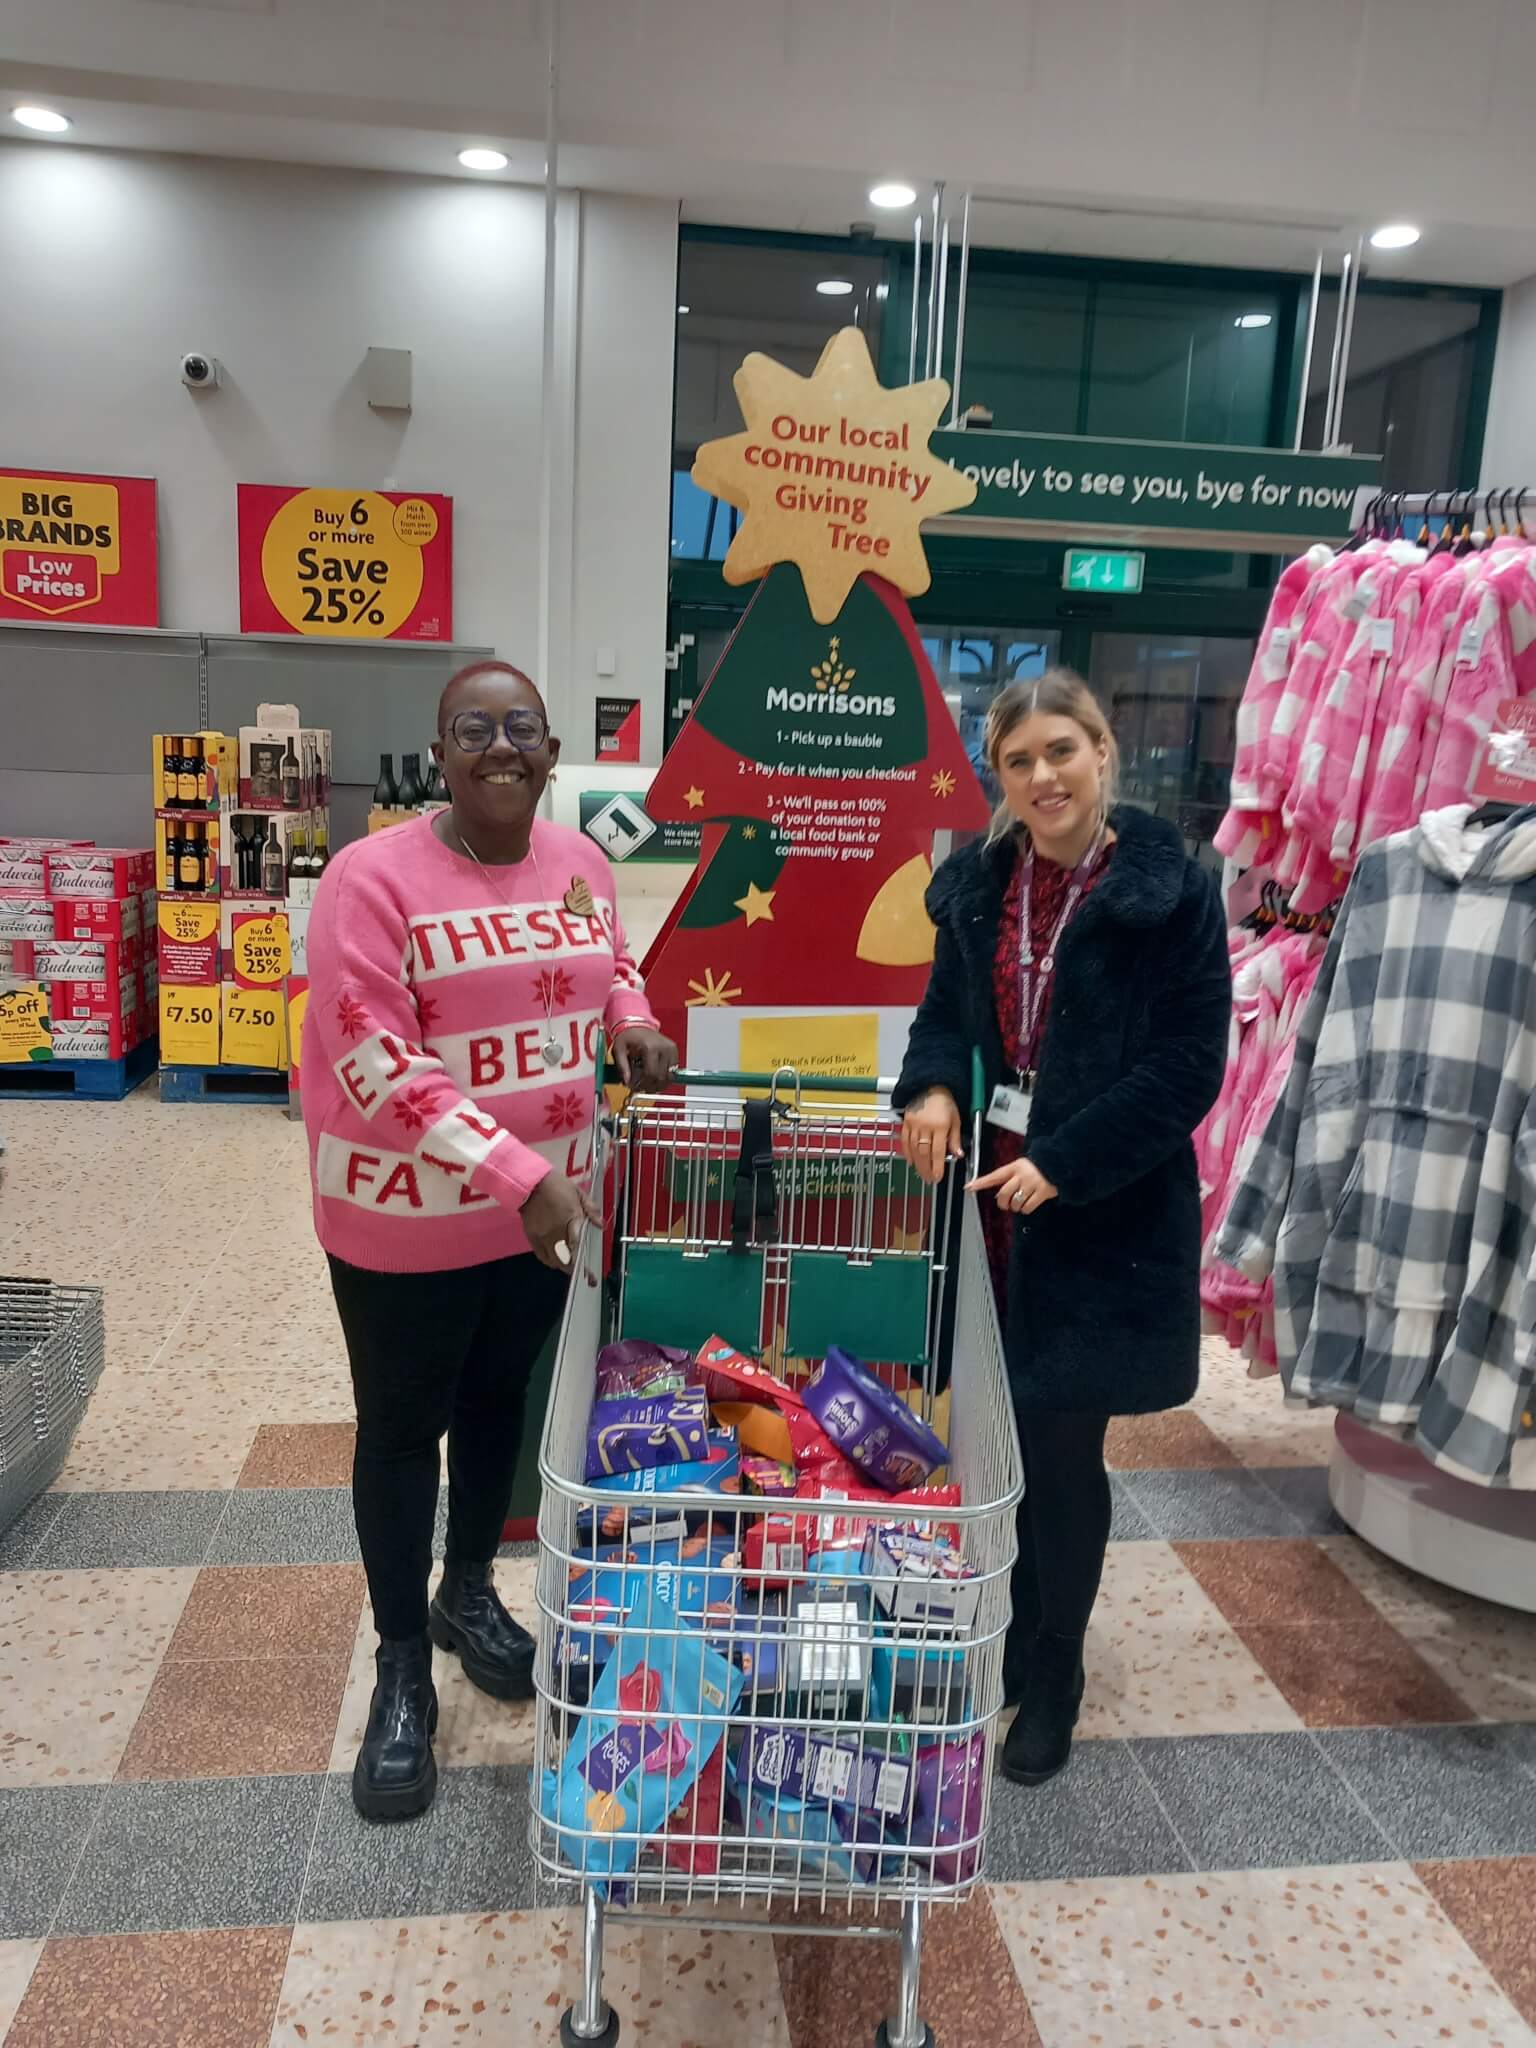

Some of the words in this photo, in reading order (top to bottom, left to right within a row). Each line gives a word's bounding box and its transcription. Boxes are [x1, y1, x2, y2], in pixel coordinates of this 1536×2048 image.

[772, 415, 831, 445] Our
[839, 417, 909, 451] local
[744, 445, 931, 503] community
[1042, 468, 1073, 492] to
[1080, 472, 1124, 497] see
[1130, 476, 1188, 504] you,
[1197, 471, 1244, 509] bye
[1249, 477, 1291, 506] for
[1297, 485, 1353, 510] now
[22, 492, 73, 518] BIG
[314, 508, 345, 529] Buy
[350, 498, 369, 526] 6
[775, 484, 869, 524] Giving
[308, 530, 327, 542] or
[332, 531, 375, 545] more
[827, 522, 890, 557] Tree
[28, 555, 73, 576] Low
[297, 547, 389, 584] Save
[17, 574, 86, 597] Prices
[301, 586, 385, 625] 25%
[765, 686, 897, 716] Morrisons
[776, 730, 782, 743] 1
[791, 730, 815, 745] Pick
[817, 734, 833, 749] up
[834, 736, 842, 746] a
[843, 731, 883, 748] bauble
[738, 761, 746, 775] 2
[755, 761, 776, 779] Pay
[777, 762, 796, 777] for
[797, 763, 806, 777] it
[808, 763, 840, 779] when
[841, 767, 865, 782] you
[865, 765, 917, 782] checkout
[766, 794, 774, 808] 3
[783, 794, 812, 810] We'll
[814, 799, 839, 813] pass
[840, 800, 856, 811] on
[858, 798, 887, 812] 100%
[771, 810, 786, 825] of
[787, 813, 813, 828] your
[814, 811, 866, 827] donation
[867, 814, 881, 828] to
[663, 828, 676, 838] We
[769, 829, 777, 840] a
[779, 825, 806, 841] local
[808, 826, 837, 842] food
[838, 828, 866, 843] bank
[867, 832, 881, 843] or
[775, 845, 840, 861] community
[841, 846, 875, 862] group
[175, 917, 200, 928] Save
[180, 909, 187, 917] 6
[176, 927, 199, 938] 25%
[250, 927, 263, 936] Buy
[264, 923, 272, 935] 6
[243, 943, 282, 957] Save
[246, 959, 281, 974] 25%
[17, 998, 40, 1014] off
[166, 1006, 213, 1024] £7.50
[228, 1007, 275, 1027] £7.50
[810, 1055, 833, 1065] Food
[835, 1053, 857, 1063] Bank
[772, 1163, 800, 1180] hare
[829, 1398, 860, 1433] HEROES
